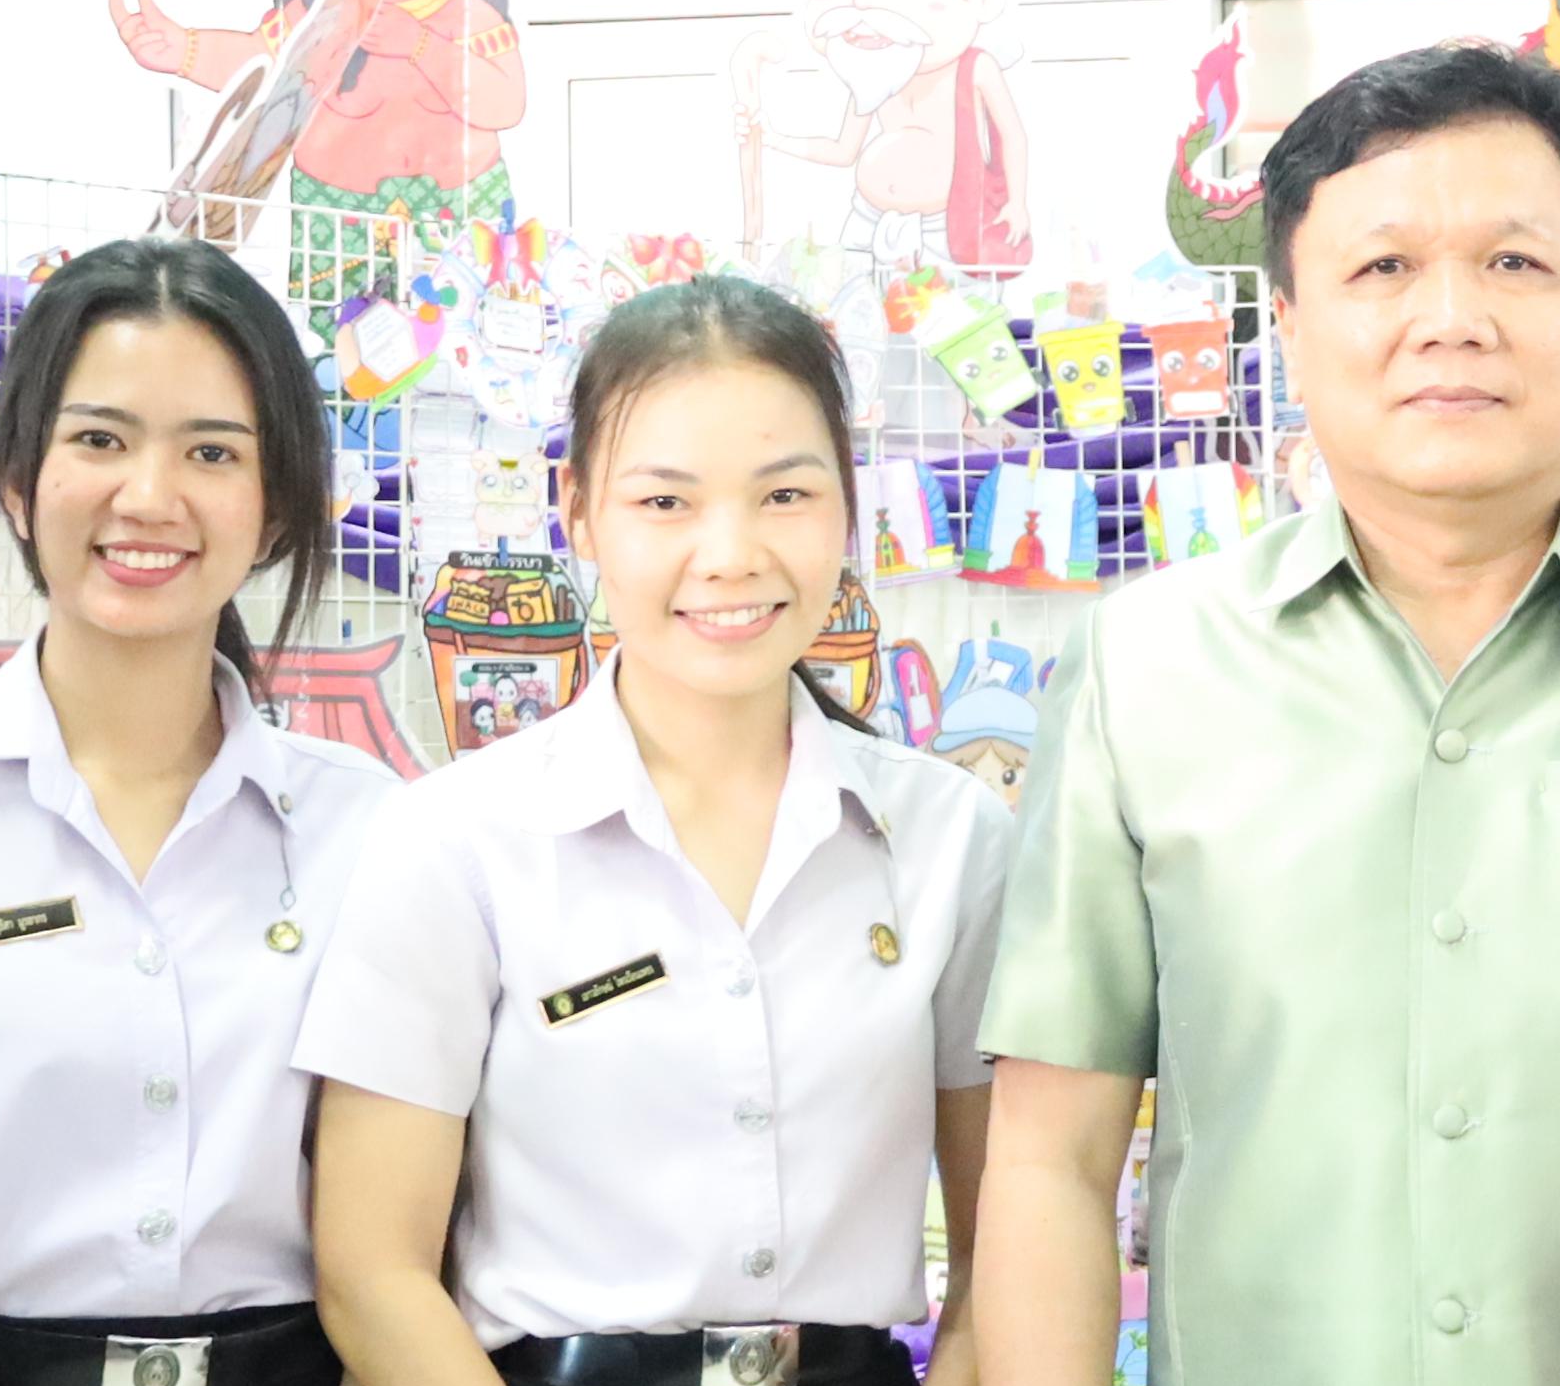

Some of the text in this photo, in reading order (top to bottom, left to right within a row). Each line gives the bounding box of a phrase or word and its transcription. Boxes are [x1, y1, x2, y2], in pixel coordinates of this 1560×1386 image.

[459, 553, 543, 569] วันเข้ารรษา
